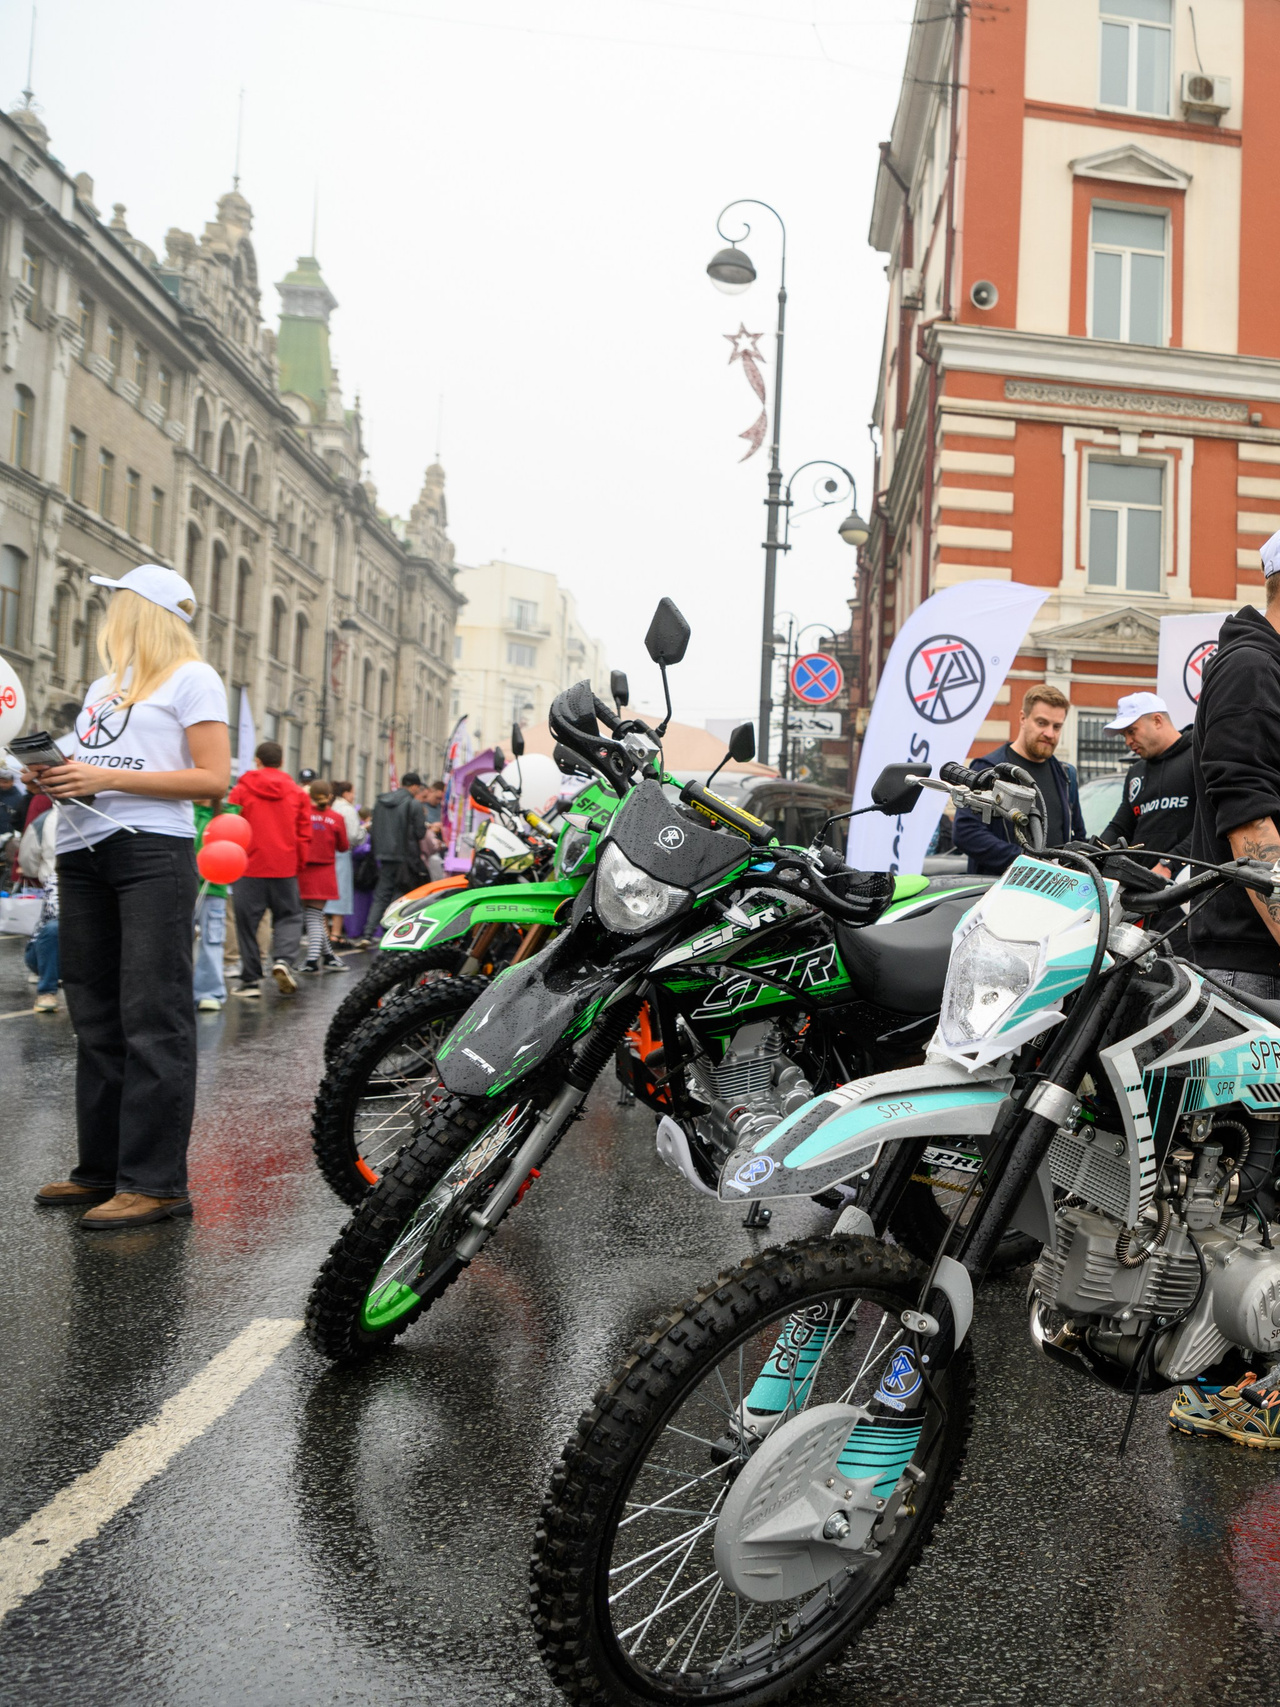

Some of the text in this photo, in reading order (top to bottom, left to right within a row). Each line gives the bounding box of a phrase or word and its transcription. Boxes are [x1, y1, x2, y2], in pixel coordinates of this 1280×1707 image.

[461, 1047, 496, 1075] SPR
[1216, 1081, 1235, 1096] SPR
[877, 1100, 918, 1119] SPR
